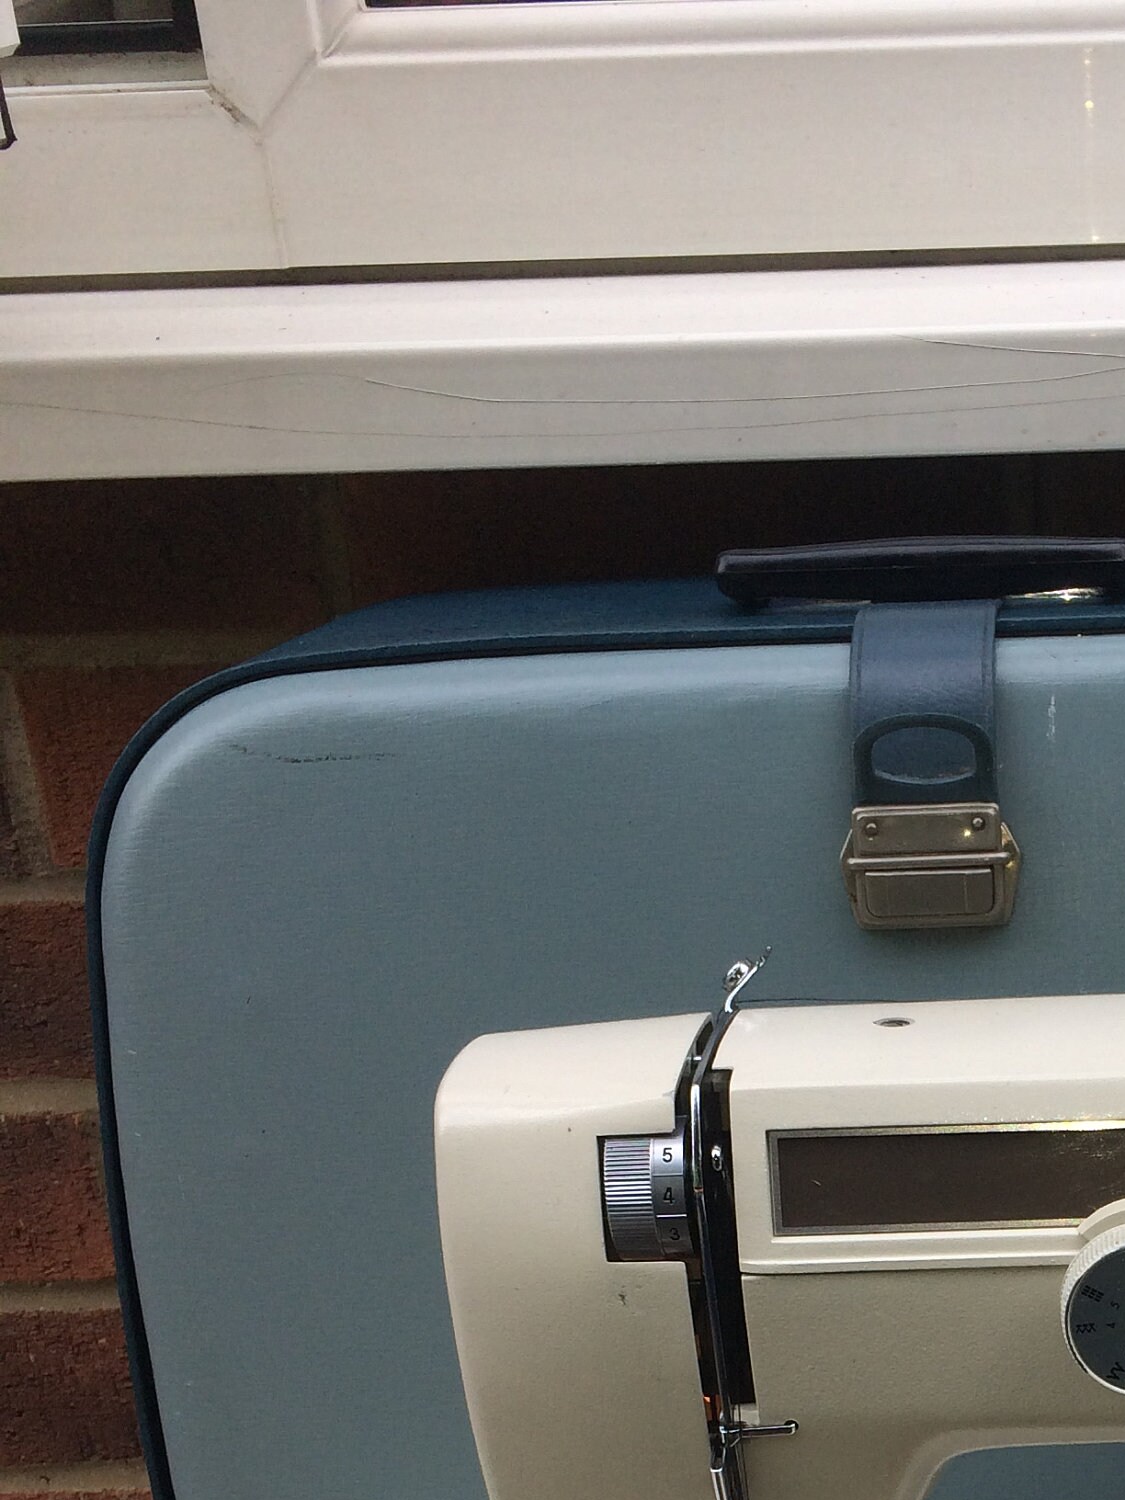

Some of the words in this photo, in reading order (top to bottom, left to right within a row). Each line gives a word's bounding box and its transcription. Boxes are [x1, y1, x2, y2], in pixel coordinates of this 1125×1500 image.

[662, 1147, 673, 1163] 5
[663, 1187, 675, 1204] 4
[669, 1228, 681, 1241] 3
[1110, 1300, 1120, 1310] 5
